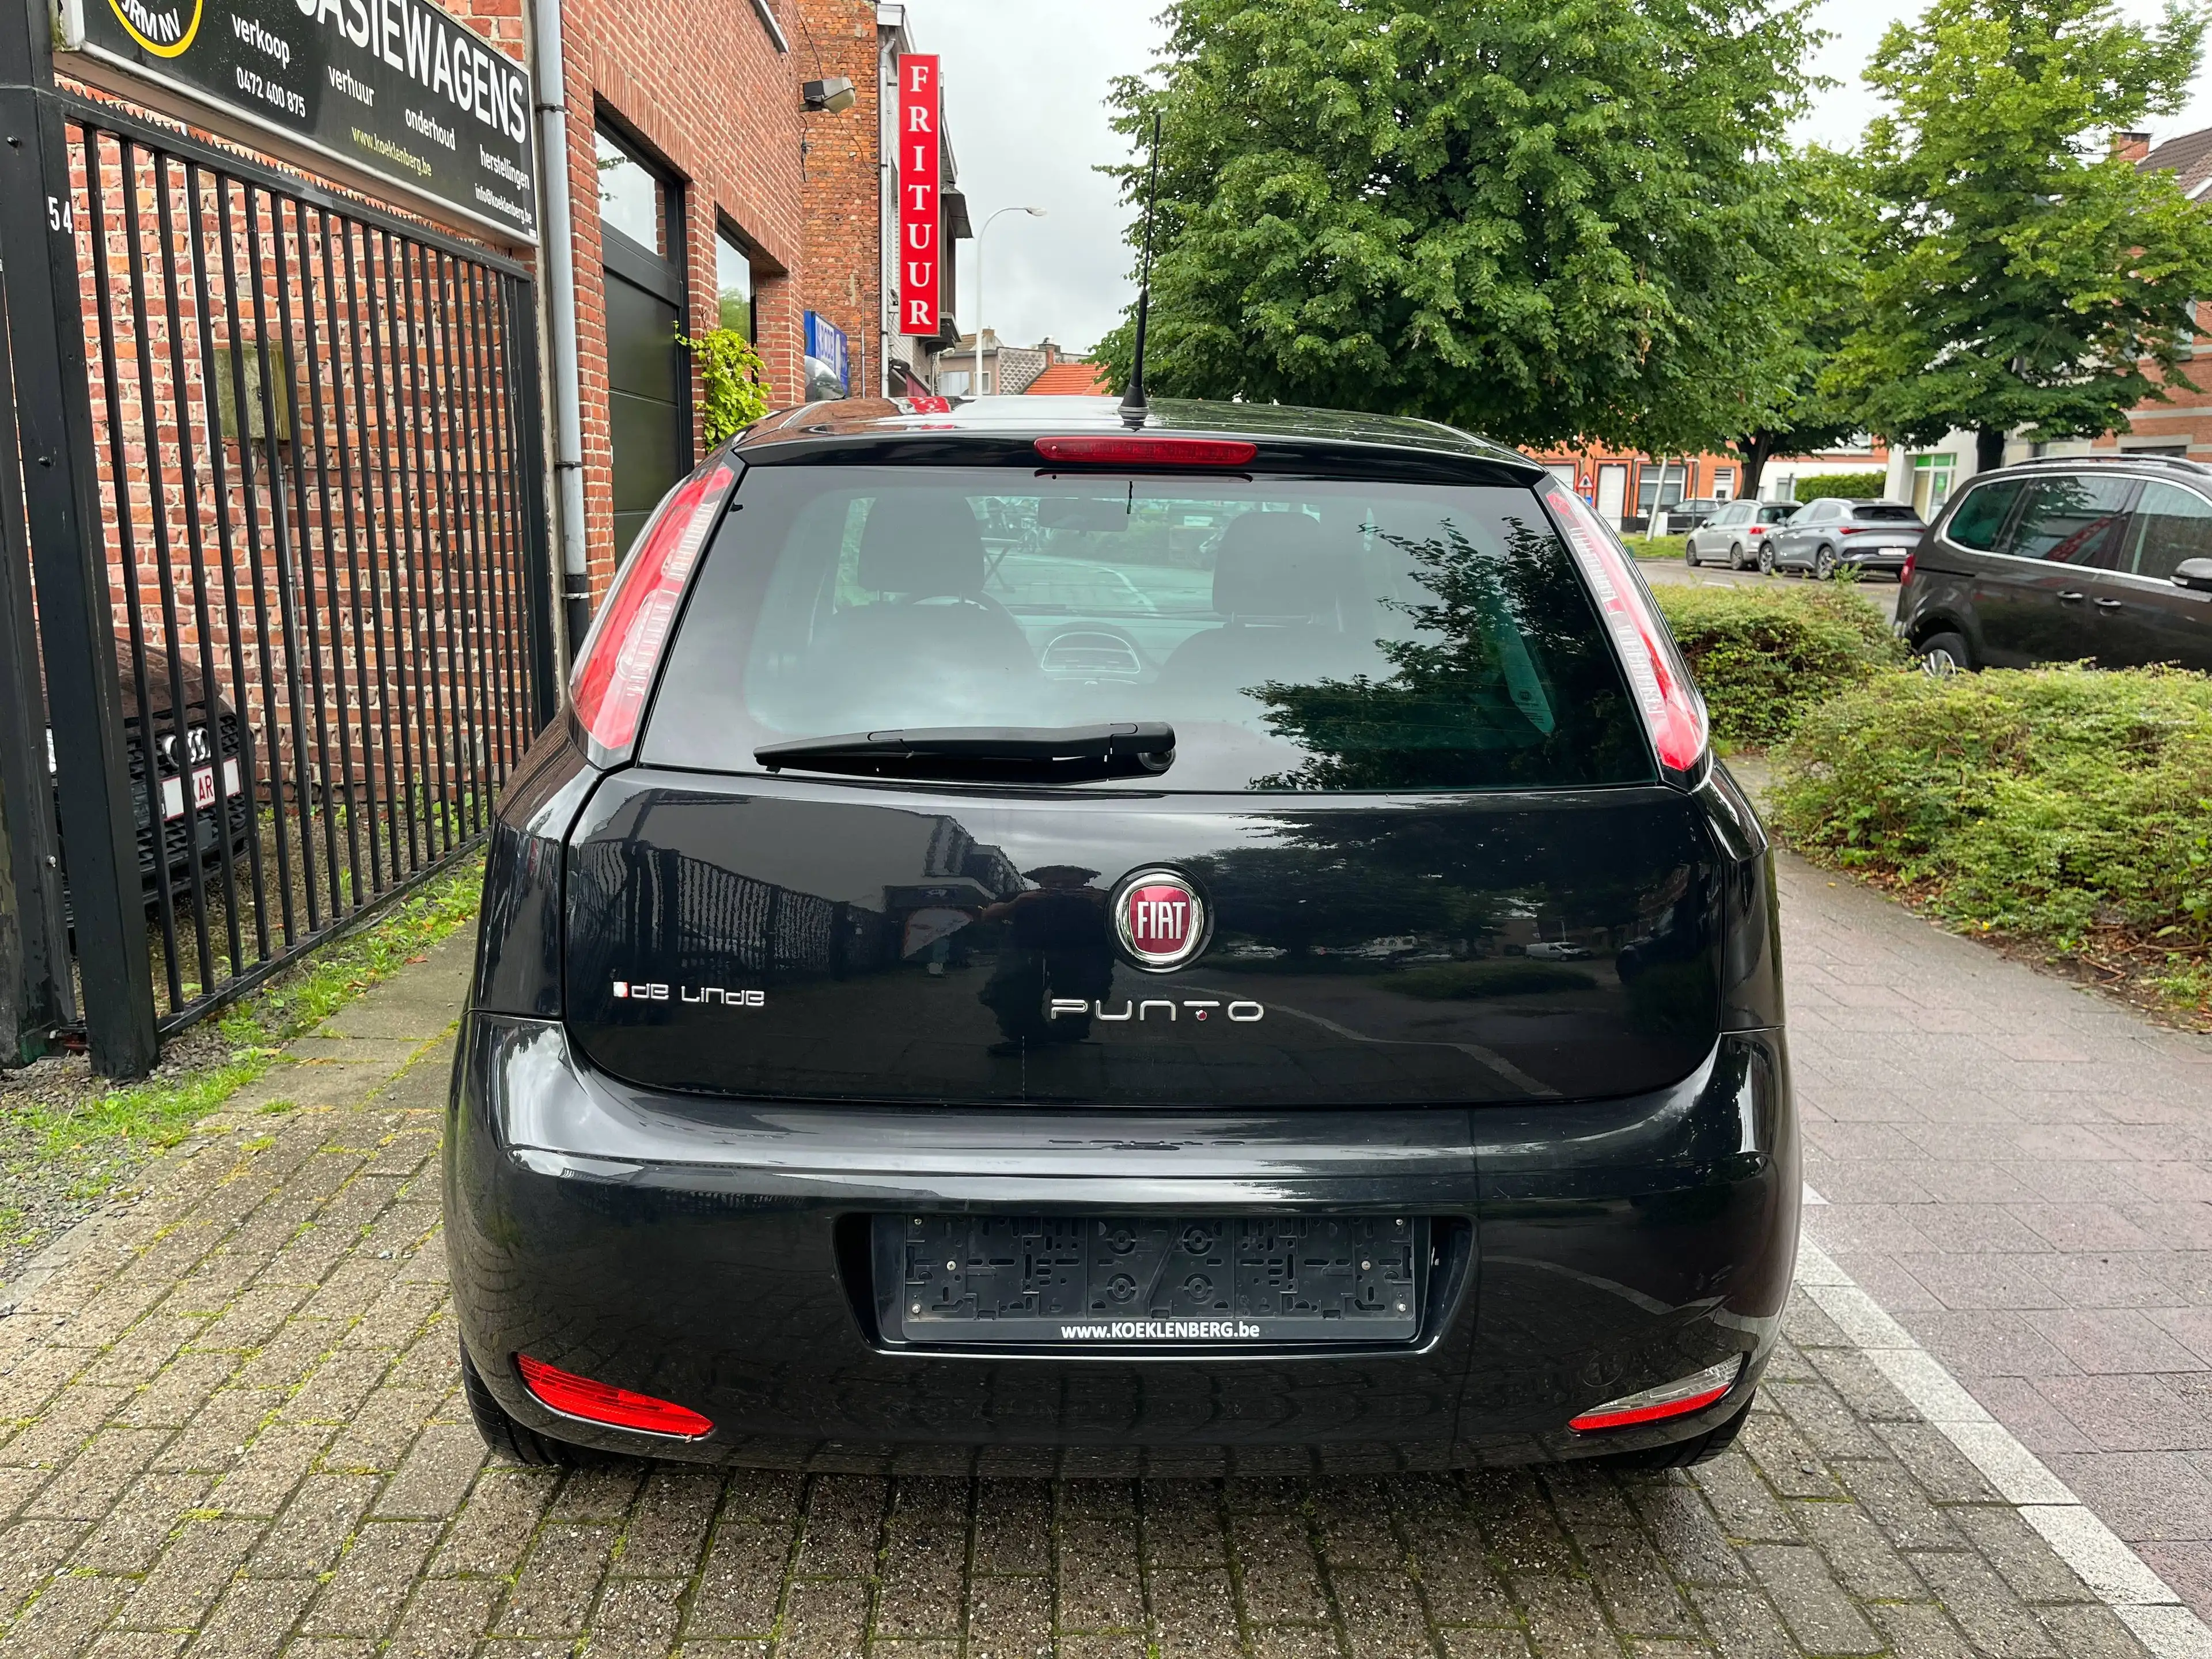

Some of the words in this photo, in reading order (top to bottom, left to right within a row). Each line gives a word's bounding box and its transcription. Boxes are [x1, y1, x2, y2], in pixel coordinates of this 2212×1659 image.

[158, 7, 181, 42] NV
[232, 14, 290, 69] verkoop
[236, 66, 264, 99] 0472
[266, 81, 285, 108] 400
[286, 90, 305, 118] 875
[328, 65, 375, 107] verhuur
[405, 108, 456, 151] onderhoud
[351, 126, 432, 177] www.koeklenberg.be
[479, 144, 530, 190] herstellingen
[48, 196, 73, 234] 54
[474, 183, 532, 225] info@koeklenberg.be
[908, 65, 932, 326] FRITUUR
[1137, 901, 1187, 940] FIAT
[1051, 998, 1264, 1021] PUNTO
[1060, 1321, 1260, 1338] www.KOEKLENBERG.be
